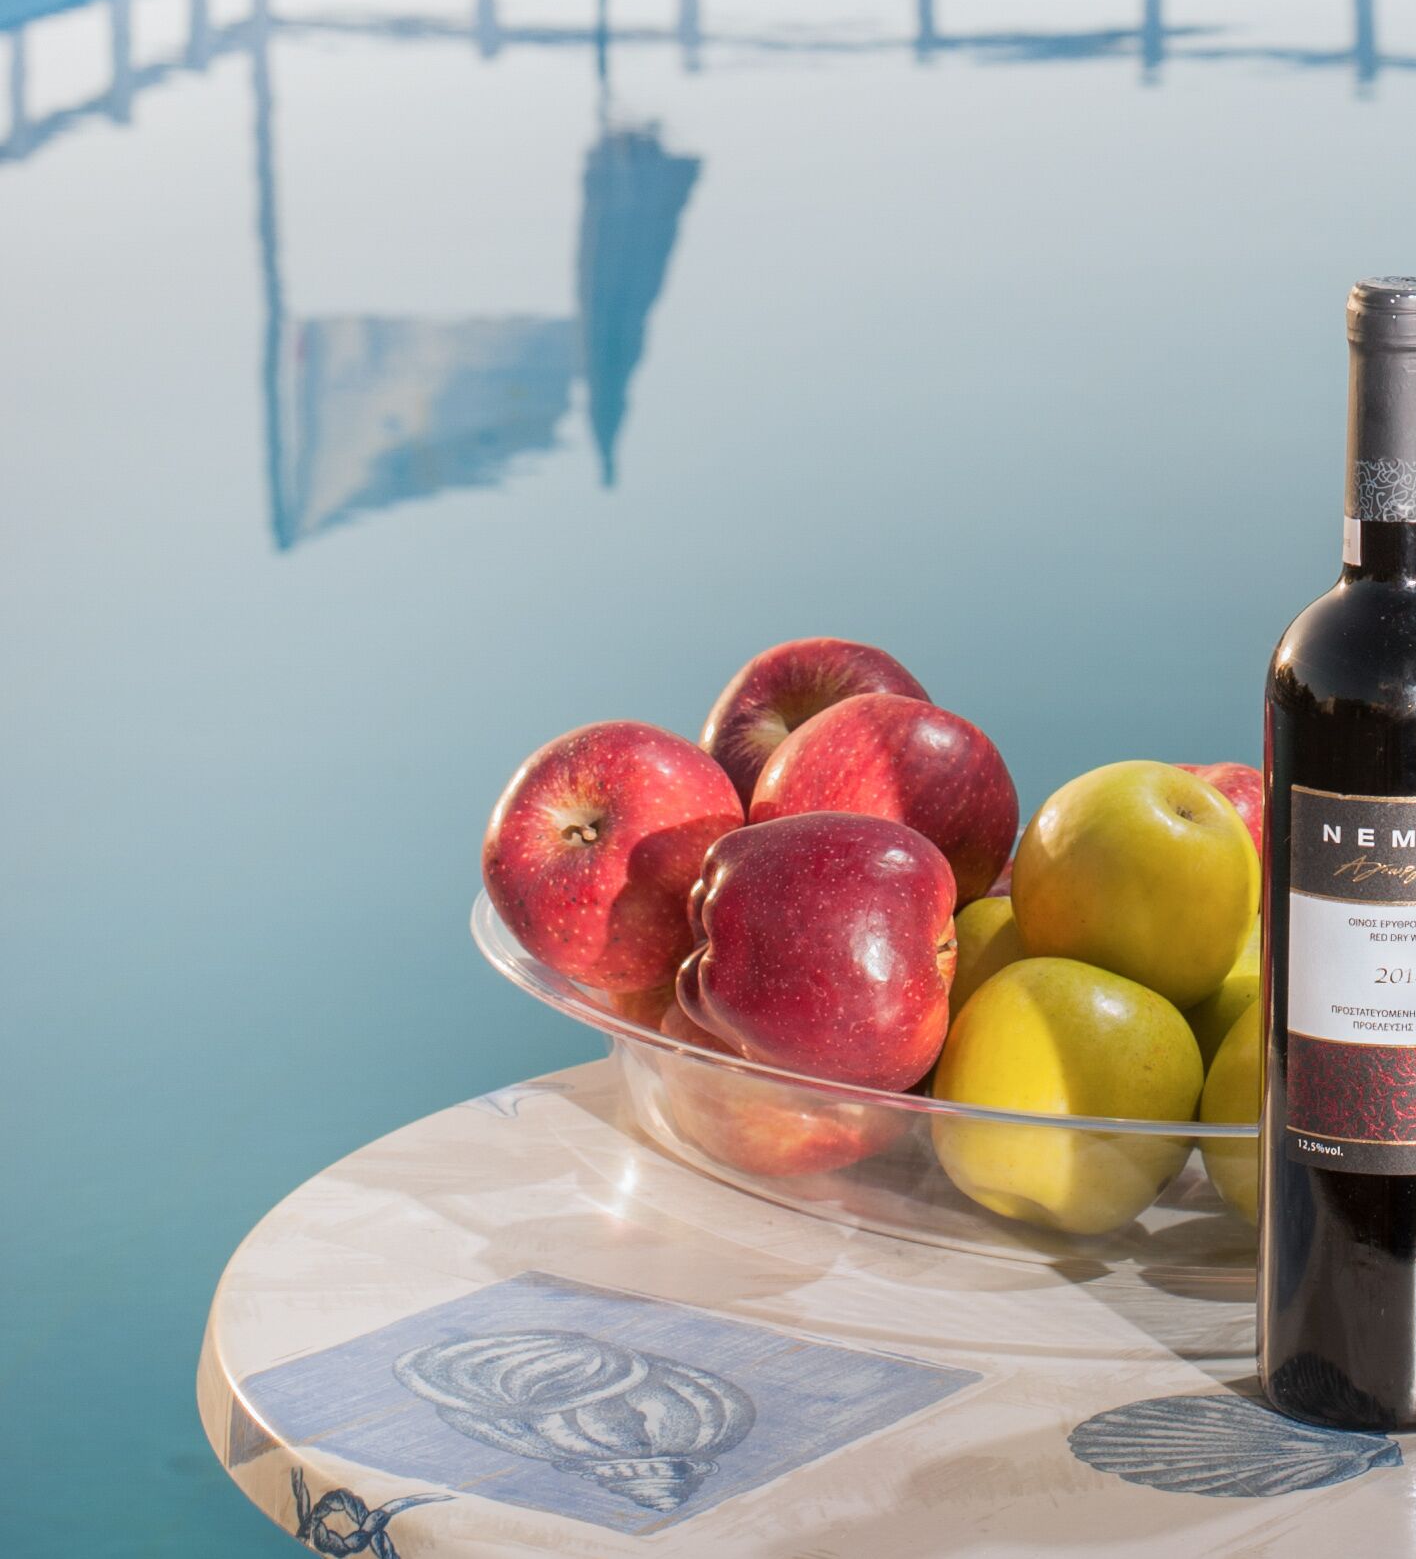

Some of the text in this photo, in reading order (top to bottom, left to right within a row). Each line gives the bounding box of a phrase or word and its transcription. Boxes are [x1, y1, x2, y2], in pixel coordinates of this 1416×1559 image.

[1348, 917, 1377, 928] ΟΙΝΟΣ
[1369, 932, 1388, 942] RED
[1390, 933, 1408, 942] DRY
[1331, 1004, 1416, 1018] ΠΡΟΣΤΑΤΕΥΟΜΕΝΗ
[1352, 1020, 1414, 1032] ΠΡΟΕΛΕΥΣΗΣ
